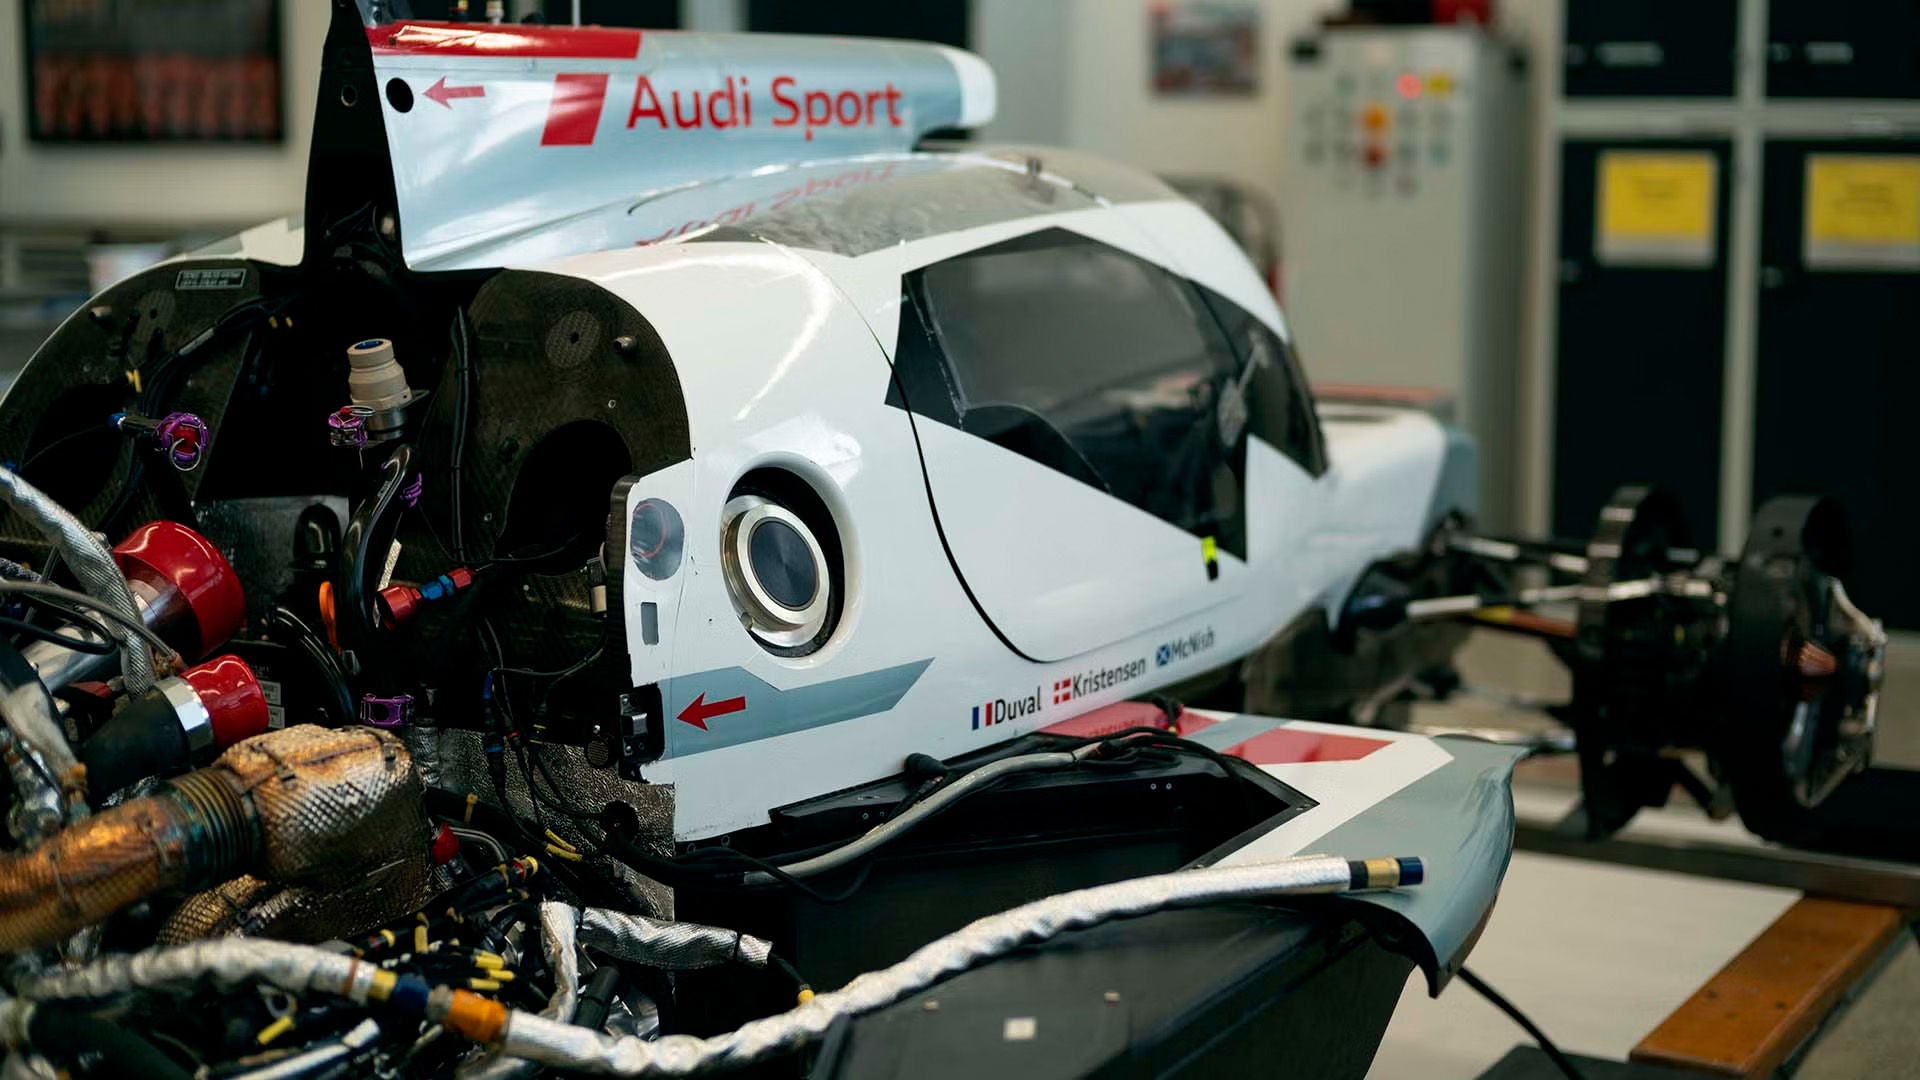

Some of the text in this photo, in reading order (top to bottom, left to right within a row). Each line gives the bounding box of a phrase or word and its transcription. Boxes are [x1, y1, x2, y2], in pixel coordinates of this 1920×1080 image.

[626, 75, 903, 142] Audi Sport
[994, 626, 1214, 724] Duval Kristensen McNish
